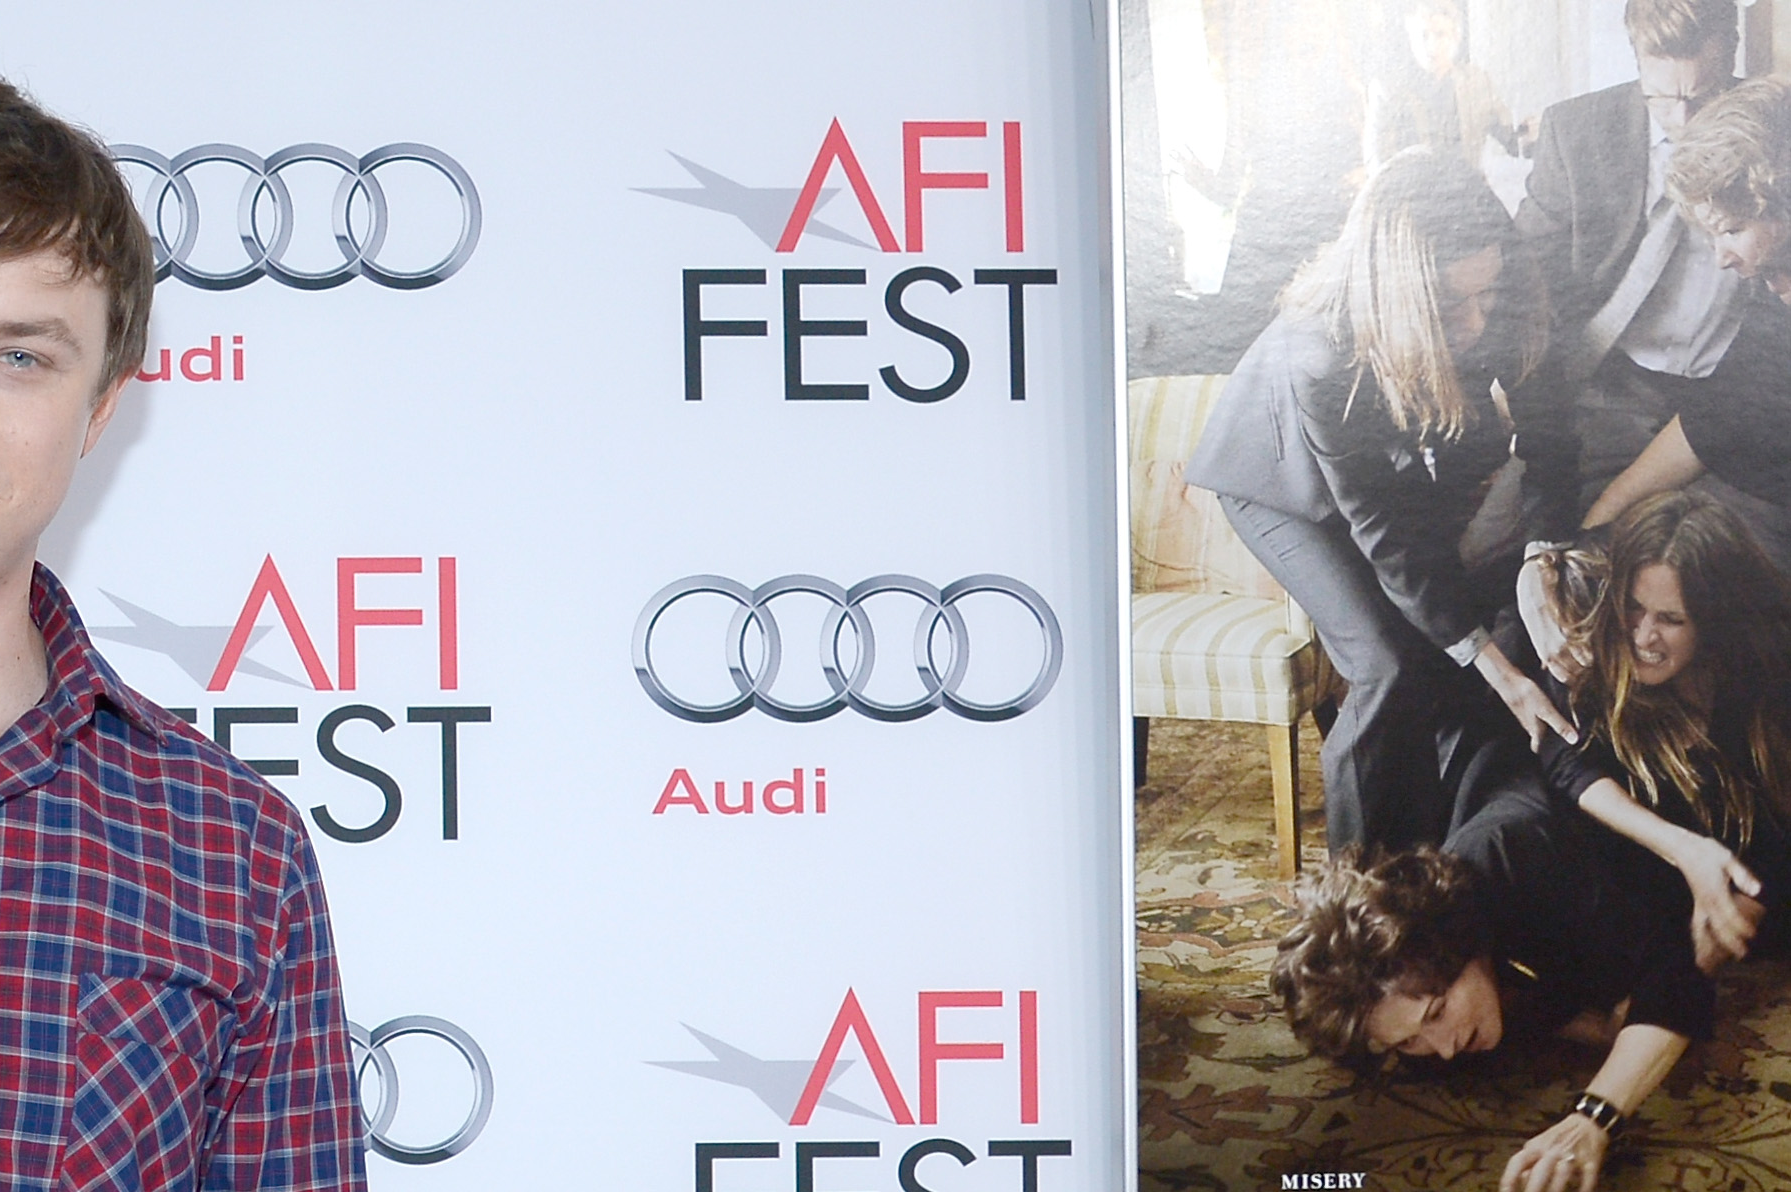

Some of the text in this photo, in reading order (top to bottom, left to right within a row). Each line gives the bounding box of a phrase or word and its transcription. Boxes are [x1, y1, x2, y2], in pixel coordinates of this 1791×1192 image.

[777, 119, 1024, 252] AFI
[135, 335, 244, 382] udi
[683, 267, 1057, 403] FEST
[206, 553, 458, 692] AFI
[164, 704, 492, 844] EST
[654, 768, 826, 814] Audi
[791, 990, 1038, 1125] AFI
[1281, 1172, 1366, 1190] MISERY
